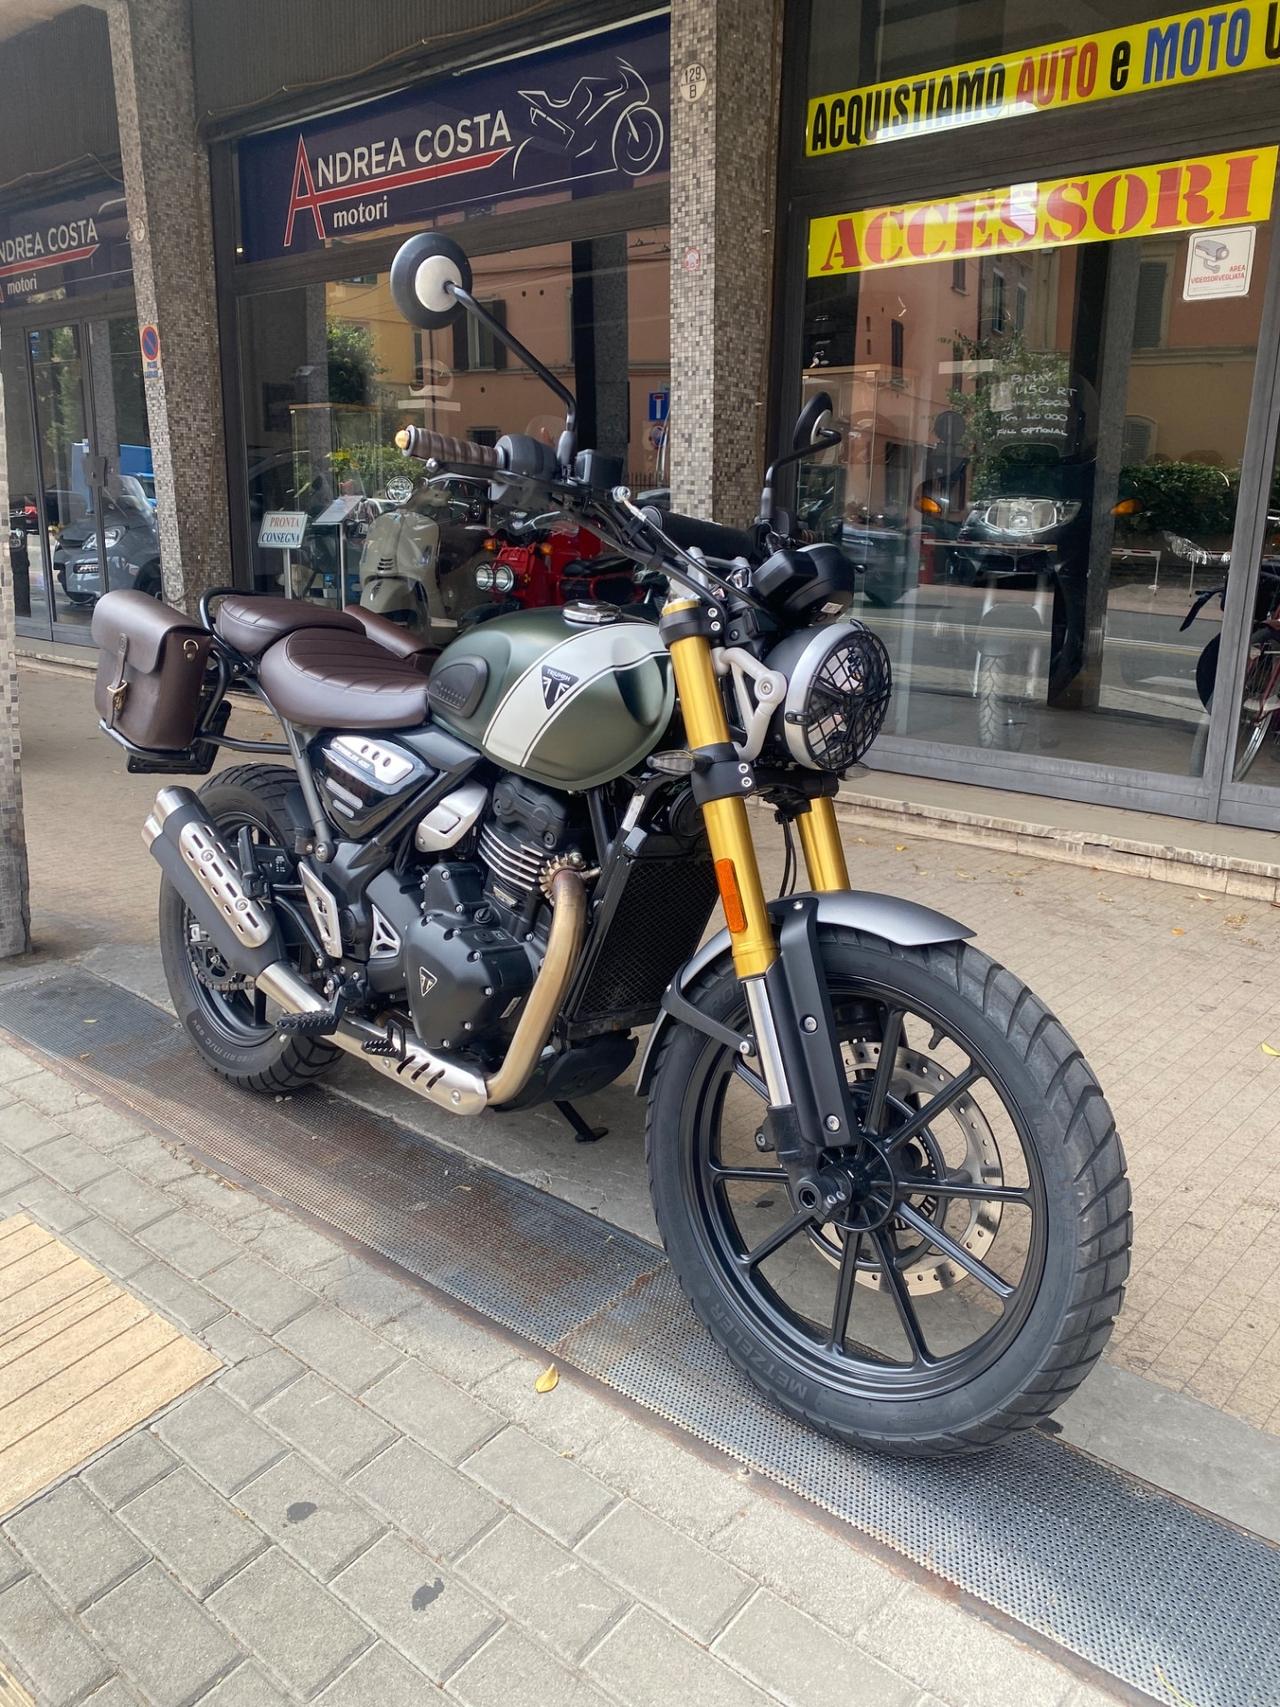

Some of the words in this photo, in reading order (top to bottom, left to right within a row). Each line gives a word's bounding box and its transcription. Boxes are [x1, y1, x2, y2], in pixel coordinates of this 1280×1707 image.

[684, 66, 702, 85] 129
[811, 62, 1007, 152] ACQUISTIAMO
[1015, 41, 1099, 109] AUTO
[1109, 40, 1132, 91] e
[1142, 7, 1251, 85] MOTO
[283, 132, 406, 247] ANDREA
[414, 109, 512, 163] COSTA
[333, 195, 389, 229] motori
[820, 154, 1260, 272] ACCESSORI
[47, 217, 99, 252] COSTA
[6, 272, 39, 296] motori
[261, 532, 300, 543] CONSEGNA
[270, 516, 300, 528] PRONTA
[546, 668, 571, 682] TRIUMPH
[709, 1303, 809, 1400] METZELER
